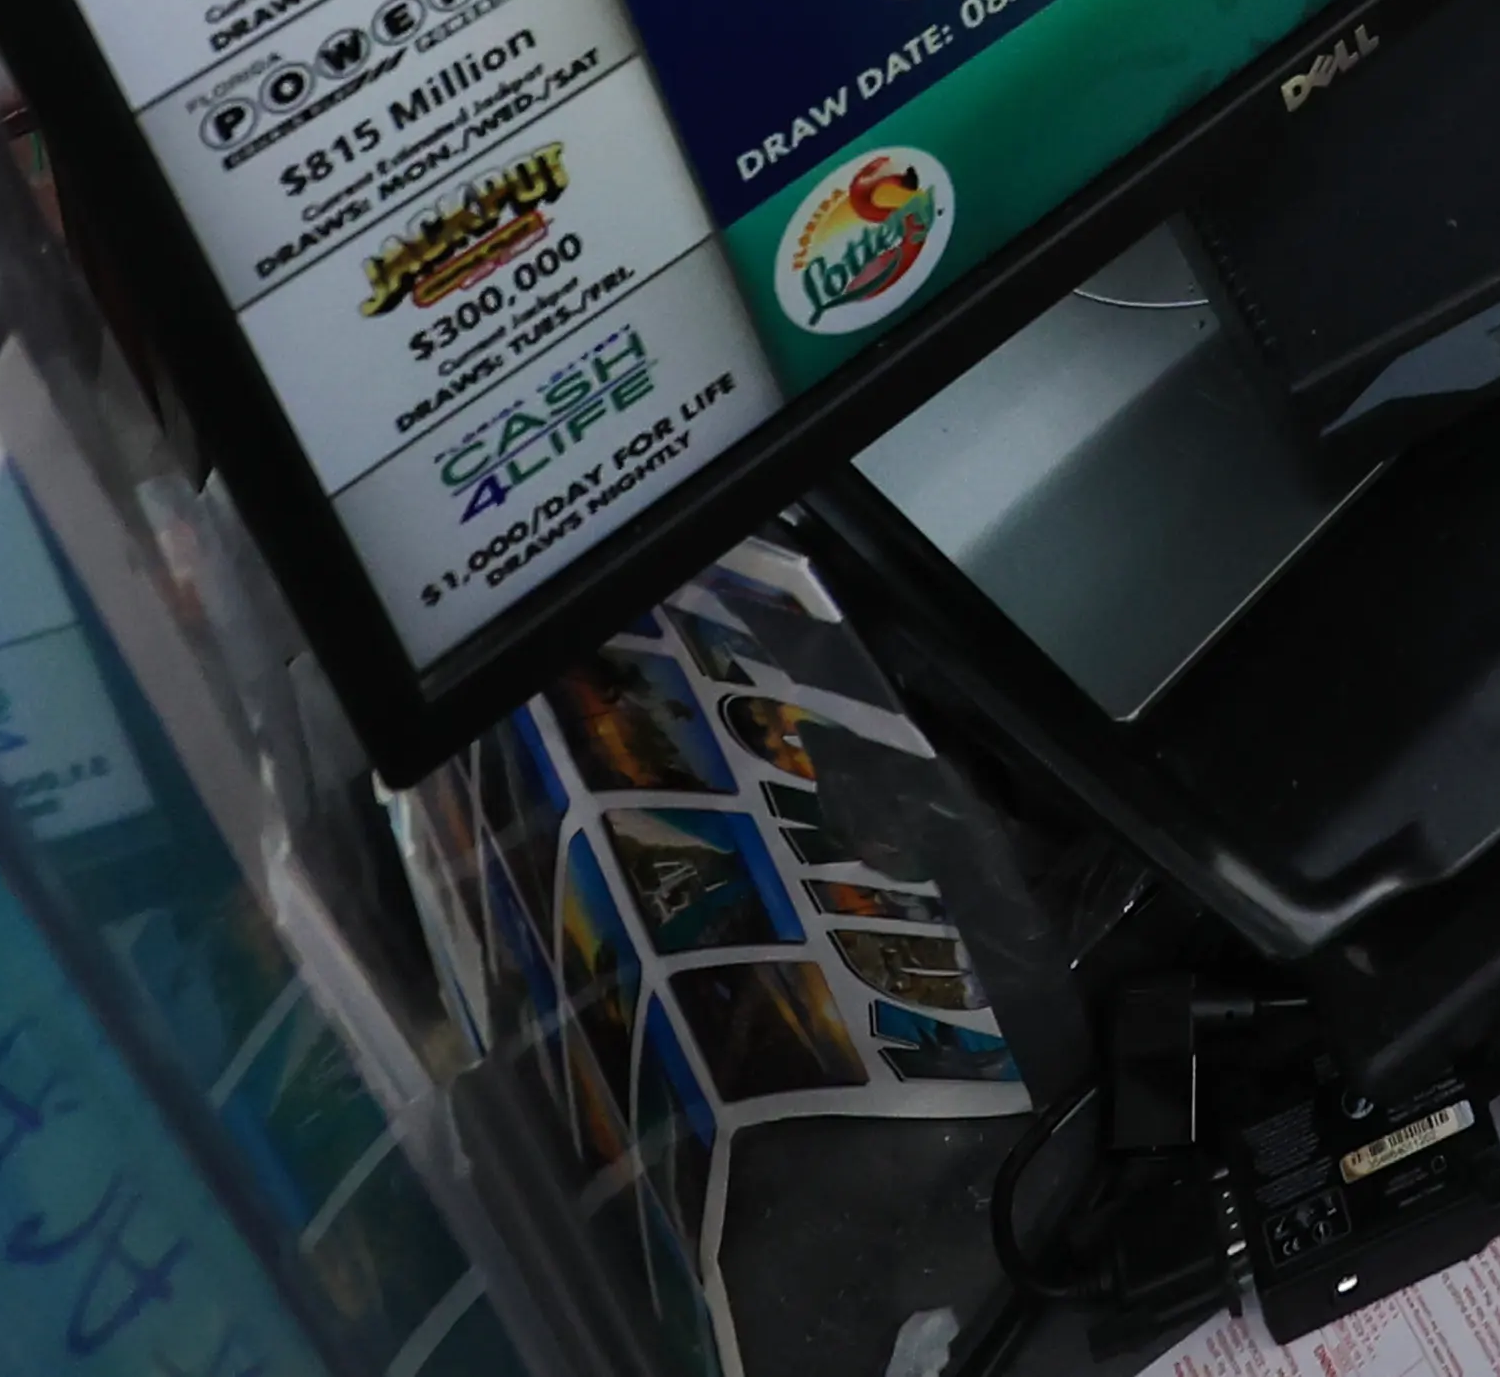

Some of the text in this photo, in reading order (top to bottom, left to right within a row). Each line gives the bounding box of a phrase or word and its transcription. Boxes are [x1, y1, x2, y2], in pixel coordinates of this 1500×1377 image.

[279, 120, 384, 198] $815
[388, 27, 537, 132] Million
[736, 87, 851, 184] DRAW
[855, 17, 958, 102] DATE:
[1279, 24, 1381, 114] DELL
[255, 199, 376, 280] DRAWS:
[408, 231, 585, 362] $300,000
[798, 181, 939, 328] Lottery
[394, 362, 503, 435] DRAWS:
[419, 457, 608, 608] $1,000/DAY
[611, 422, 677, 482] FOR
[679, 371, 737, 434] LIFE
